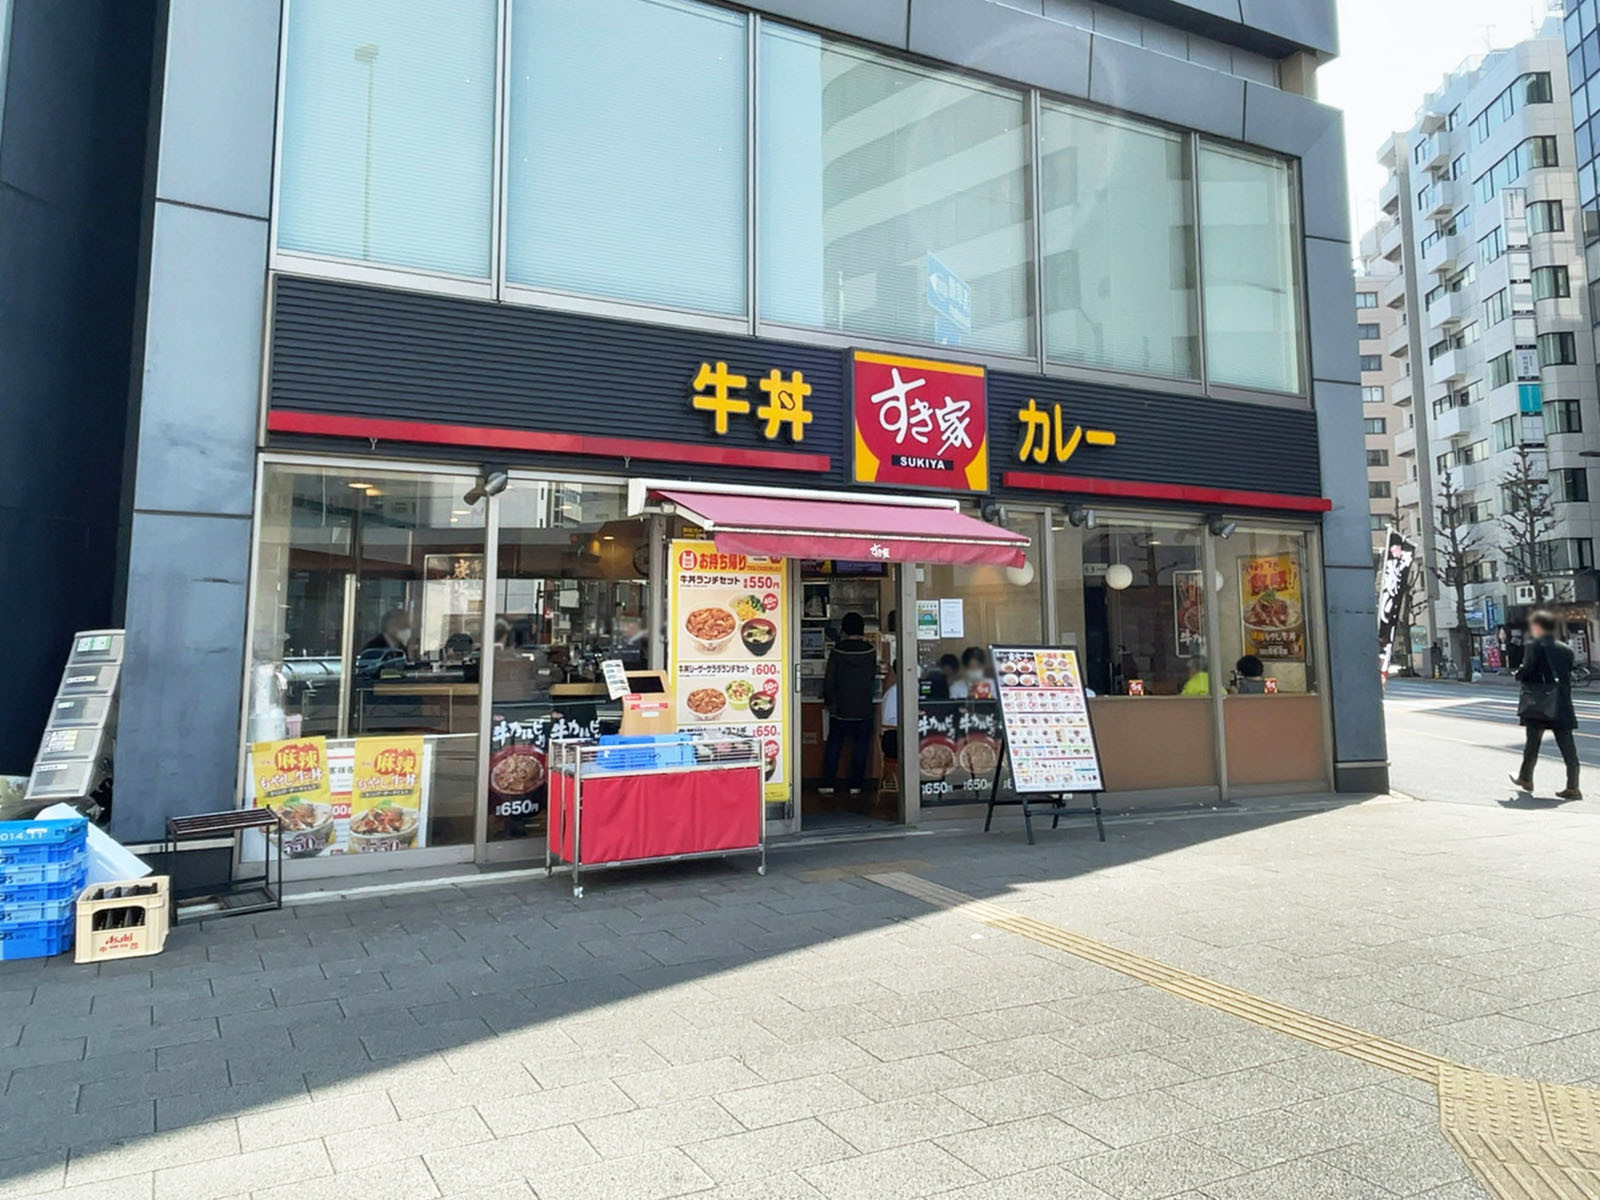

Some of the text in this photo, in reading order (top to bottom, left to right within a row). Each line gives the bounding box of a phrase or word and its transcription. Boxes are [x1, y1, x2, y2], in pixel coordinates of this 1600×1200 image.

[692, 361, 813, 442] 牛丼
[871, 368, 973, 455] すき家
[1018, 398, 1117, 464] カレー
[900, 456, 945, 469] SUKIYA
[680, 575, 740, 585] 牛丼ランチセット
[278, 750, 318, 770] 麻辣
[377, 753, 414, 772] 麻辣
[105, 933, 133, 945] Asahi
